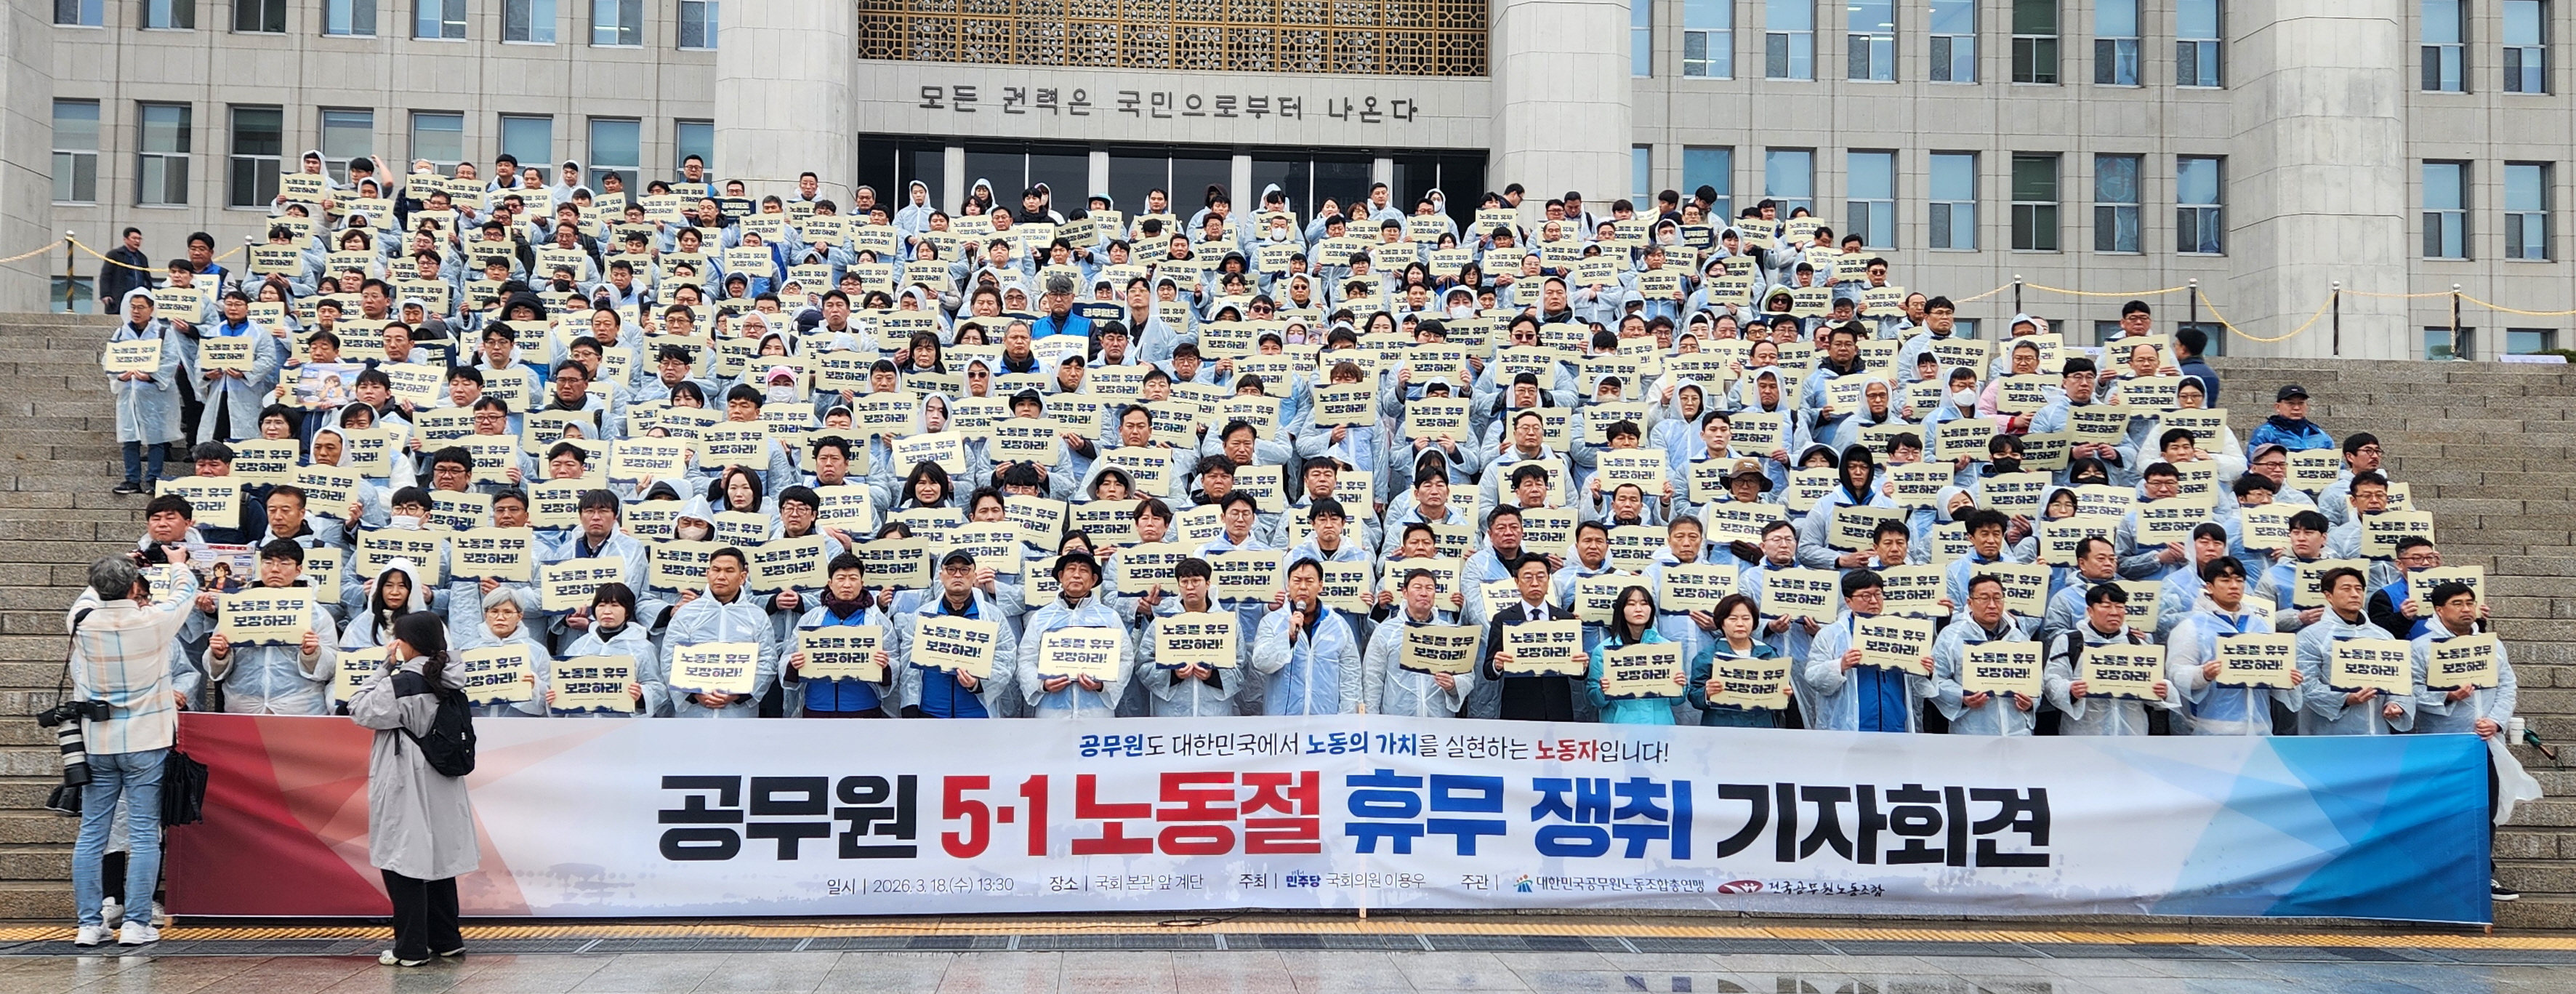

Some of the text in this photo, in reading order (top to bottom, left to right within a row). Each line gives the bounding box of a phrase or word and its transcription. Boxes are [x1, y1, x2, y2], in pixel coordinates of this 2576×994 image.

[919, 86, 1418, 123] 모든 권력은 국민으로부터 나온다
[1320, 392, 1371, 402] 노동절 휴무
[859, 403, 889, 412] 노동절
[1325, 404, 1367, 413] 보장하라!
[864, 414, 908, 423] 보장하라!
[2073, 412, 2105, 422] 노동절
[997, 428, 1053, 438] 노동절 휴무
[1941, 428, 1968, 437] 노동절
[2076, 423, 2121, 433] 보장하라!
[704, 432, 762, 441] 노동절 휴무
[709, 444, 757, 454] 보장하라!
[898, 442, 930, 452] 노동절
[1001, 440, 1047, 449] 보장하라!
[1945, 439, 1986, 449] 보장하라!
[1603, 458, 1635, 467] 노동절
[1609, 470, 1655, 479] 보장하라!
[458, 538, 525, 549] 노동절 휴무
[464, 553, 518, 564] 보장하라!
[754, 547, 819, 563] 노동절 휴무
[761, 561, 815, 577] 보장하라!
[1769, 577, 1832, 592] 노동절 휴무
[1774, 592, 1825, 606] 보장하라!
[227, 600, 303, 612] 노동절 휴무
[233, 615, 296, 627] 보장하라!
[922, 625, 989, 644] 노동절 휴무
[1163, 625, 1228, 635] 노동절 휴무
[1861, 625, 1925, 641] 노동절 휴무
[806, 638, 875, 649] 노동절 휴무
[1047, 638, 1114, 649] 노동절 휴무
[1169, 639, 1223, 649] 보장하라!
[1409, 633, 1474, 647] 노동절 휴무
[1510, 633, 1575, 643] 노동절 휴무
[926, 640, 981, 658] 보장하라!
[1414, 646, 1467, 660] 보장하라!
[1516, 647, 1570, 657] 보장하라!
[1865, 640, 1919, 655] 보장하라!
[2223, 645, 2288, 655] 노동절 휴무
[2436, 645, 2491, 660] 노동절 휴무
[680, 653, 750, 664] 노동절 휴무
[812, 652, 869, 663] 보장하라!
[1052, 652, 1107, 663] 보장하라!
[1610, 654, 1675, 667] 노동절 휴무
[1971, 652, 2035, 664] 노동절 휴무
[2090, 654, 2157, 667] 노동절 휴무
[2340, 649, 2404, 662] 노동절 휴무
[2229, 660, 2283, 670] 보장하라!
[2345, 663, 2399, 676] 보장하라!
[2442, 660, 2487, 673] 보장하라!
[558, 668, 627, 678] 노동절 휴무
[685, 666, 742, 678] 보장하라!
[1617, 669, 1670, 681] 보장하라!
[1720, 667, 1784, 680] 노동절 휴무
[1977, 668, 2030, 678] 보장하라!
[2096, 669, 2151, 681] 보장하라!
[565, 683, 622, 694] 보장하라!
[1724, 681, 1778, 694] 보장하라!
[1079, 732, 1669, 763] 공무원도 대한민국에서 노동의 가치를 실현하는 노동자입니다!
[658, 774, 917, 861] 공무원
[1071, 770, 1321, 855] 노동절
[1345, 768, 1506, 857] 휴무
[1531, 777, 1692, 860] 쟁취
[1717, 782, 2050, 867] 기자회견
[827, 878, 856, 895] 일시
[978, 877, 1014, 891] 13:30
[1050, 873, 1204, 891] 장소 국회 본관 앞 계단
[1239, 873, 1426, 889] 주최 민주당 국회의원 이용우
[1461, 874, 1704, 893] 주관 대한민국공무원노동조합총연맹
[1768, 881, 1885, 897] 전국공무원노동조합
